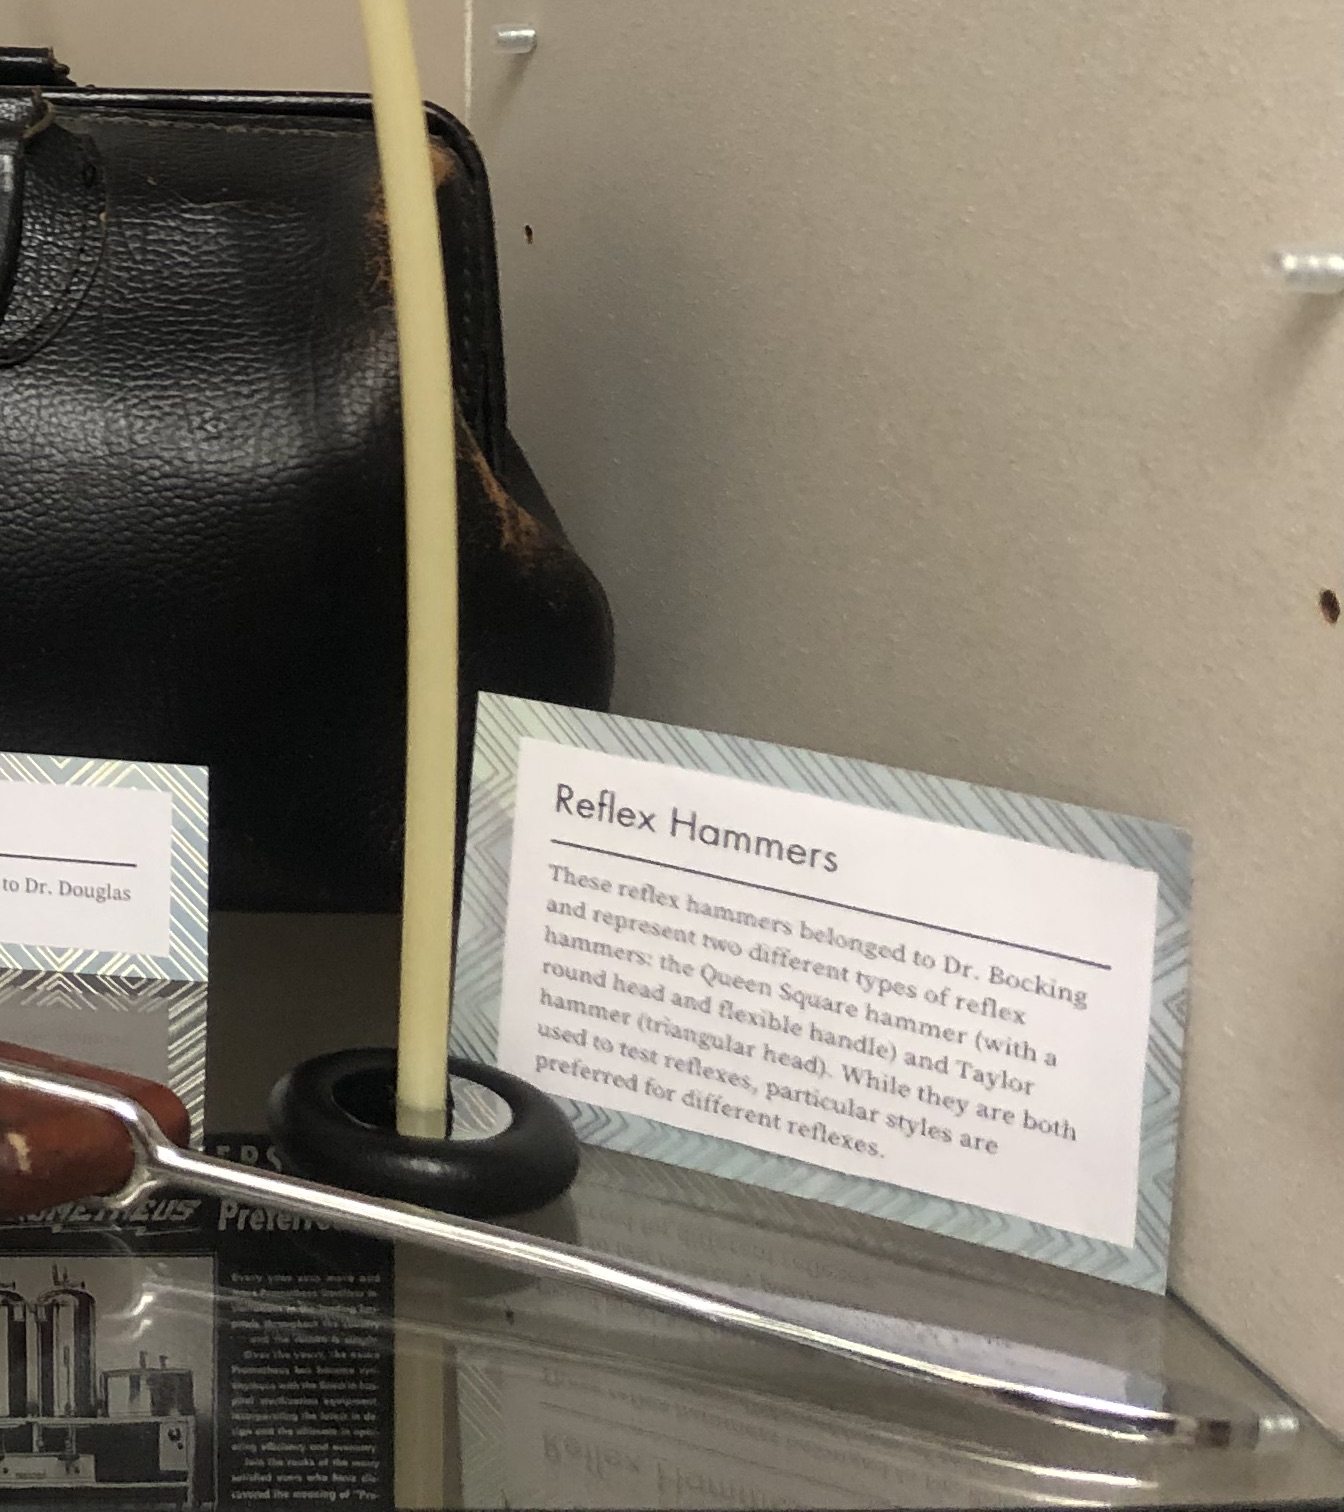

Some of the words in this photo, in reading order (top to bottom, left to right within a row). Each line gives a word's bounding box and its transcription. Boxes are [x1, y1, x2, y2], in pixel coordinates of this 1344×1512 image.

[556, 784, 655, 832] Reflex
[670, 807, 838, 872] Hammers
[3, 879, 19, 892] to
[26, 878, 52, 894] Dr.
[59, 880, 131, 903] Douglas
[549, 864, 612, 893] These
[618, 884, 679, 909] reflex
[686, 895, 792, 935] hammers
[800, 921, 906, 963] belonged
[912, 951, 935, 969] to
[944, 955, 979, 980] Dr.
[988, 966, 1087, 1010] Bocking
